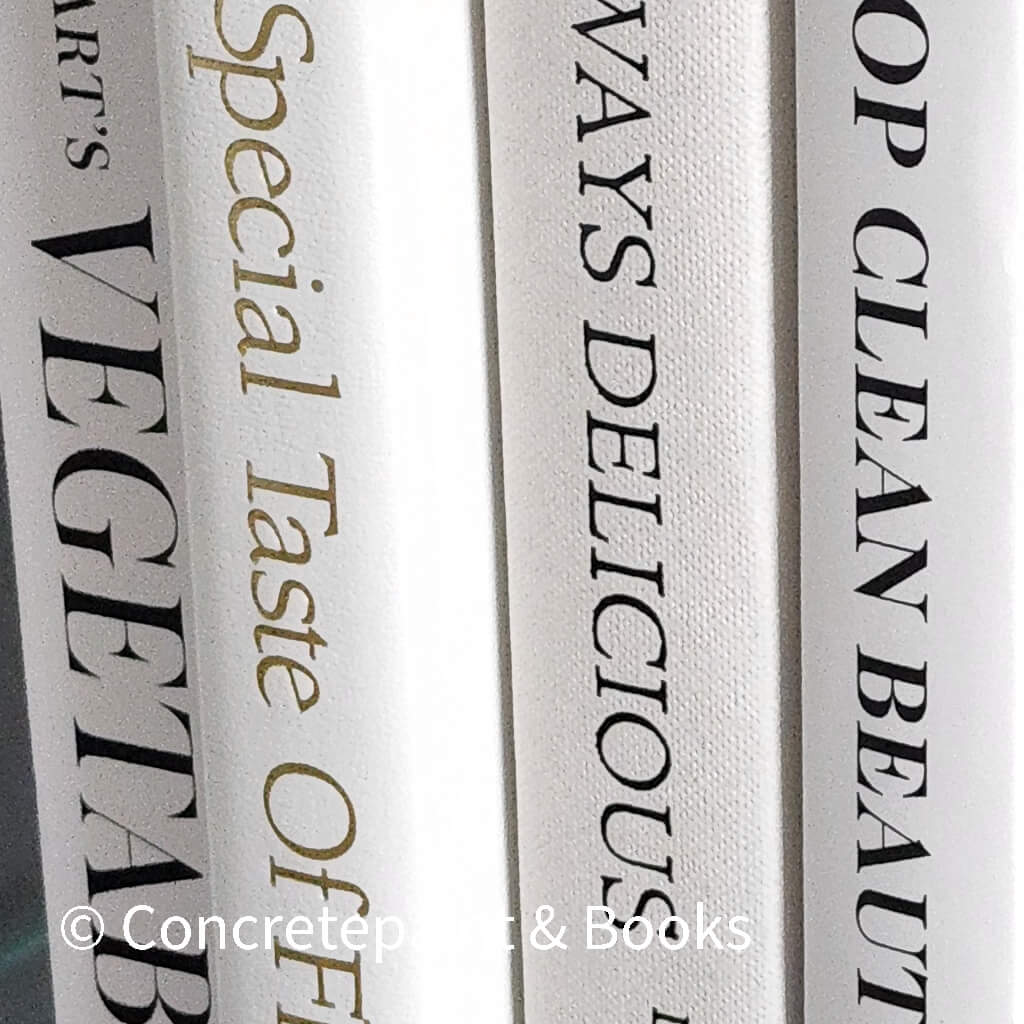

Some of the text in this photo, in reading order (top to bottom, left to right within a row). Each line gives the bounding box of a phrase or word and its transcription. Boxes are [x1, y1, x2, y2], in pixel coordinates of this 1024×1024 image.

[246, 451, 340, 714] Taste
[852, 207, 931, 623] CLEAN
[583, 319, 679, 941] DELICIOUS
[263, 762, 370, 918] Of
[855, 644, 930, 1024] BEAUT
